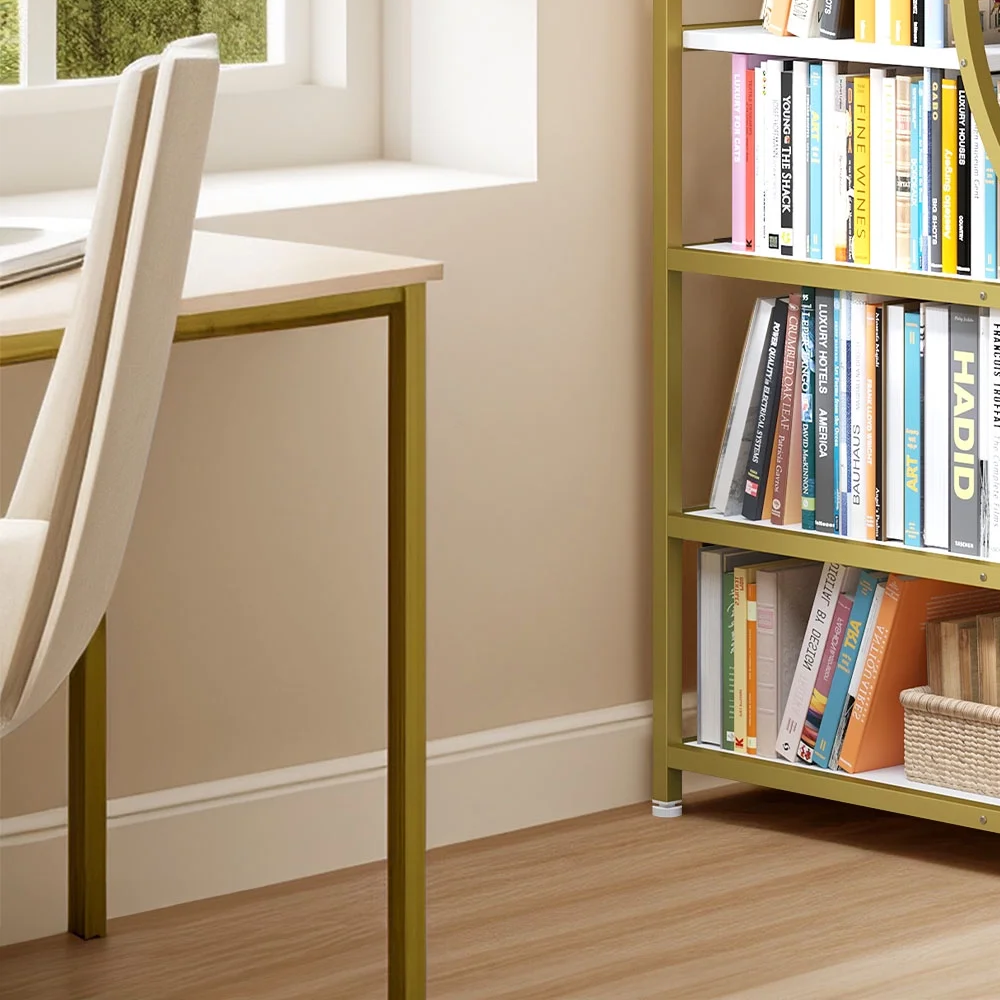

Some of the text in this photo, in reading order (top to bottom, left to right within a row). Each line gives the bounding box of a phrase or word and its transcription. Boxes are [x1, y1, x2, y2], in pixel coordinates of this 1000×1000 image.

[782, 95, 792, 135] YOUNG
[811, 111, 820, 142] ART
[958, 89, 966, 166] LUXURY HOUSES
[781, 145, 792, 213] THE SHACK
[856, 104, 866, 240] FINE WINES
[943, 149, 953, 192] Surgery
[769, 321, 781, 347] POWER
[818, 303, 828, 394] LUXURY HOTELS
[765, 347, 776, 378] QUALITY
[780, 316, 799, 431] CRUMBLED OAK LEAF
[757, 385, 770, 429] ELECTRICAL
[952, 350, 975, 500] HADID
[751, 430, 764, 464] SYSTEMS
[776, 435, 786, 463] Patricia
[818, 408, 828, 458] AMERICA
[852, 424, 861, 506] BAUHAUS
[906, 455, 919, 493] ART
[991, 435, 1000, 529] The Complete Films
